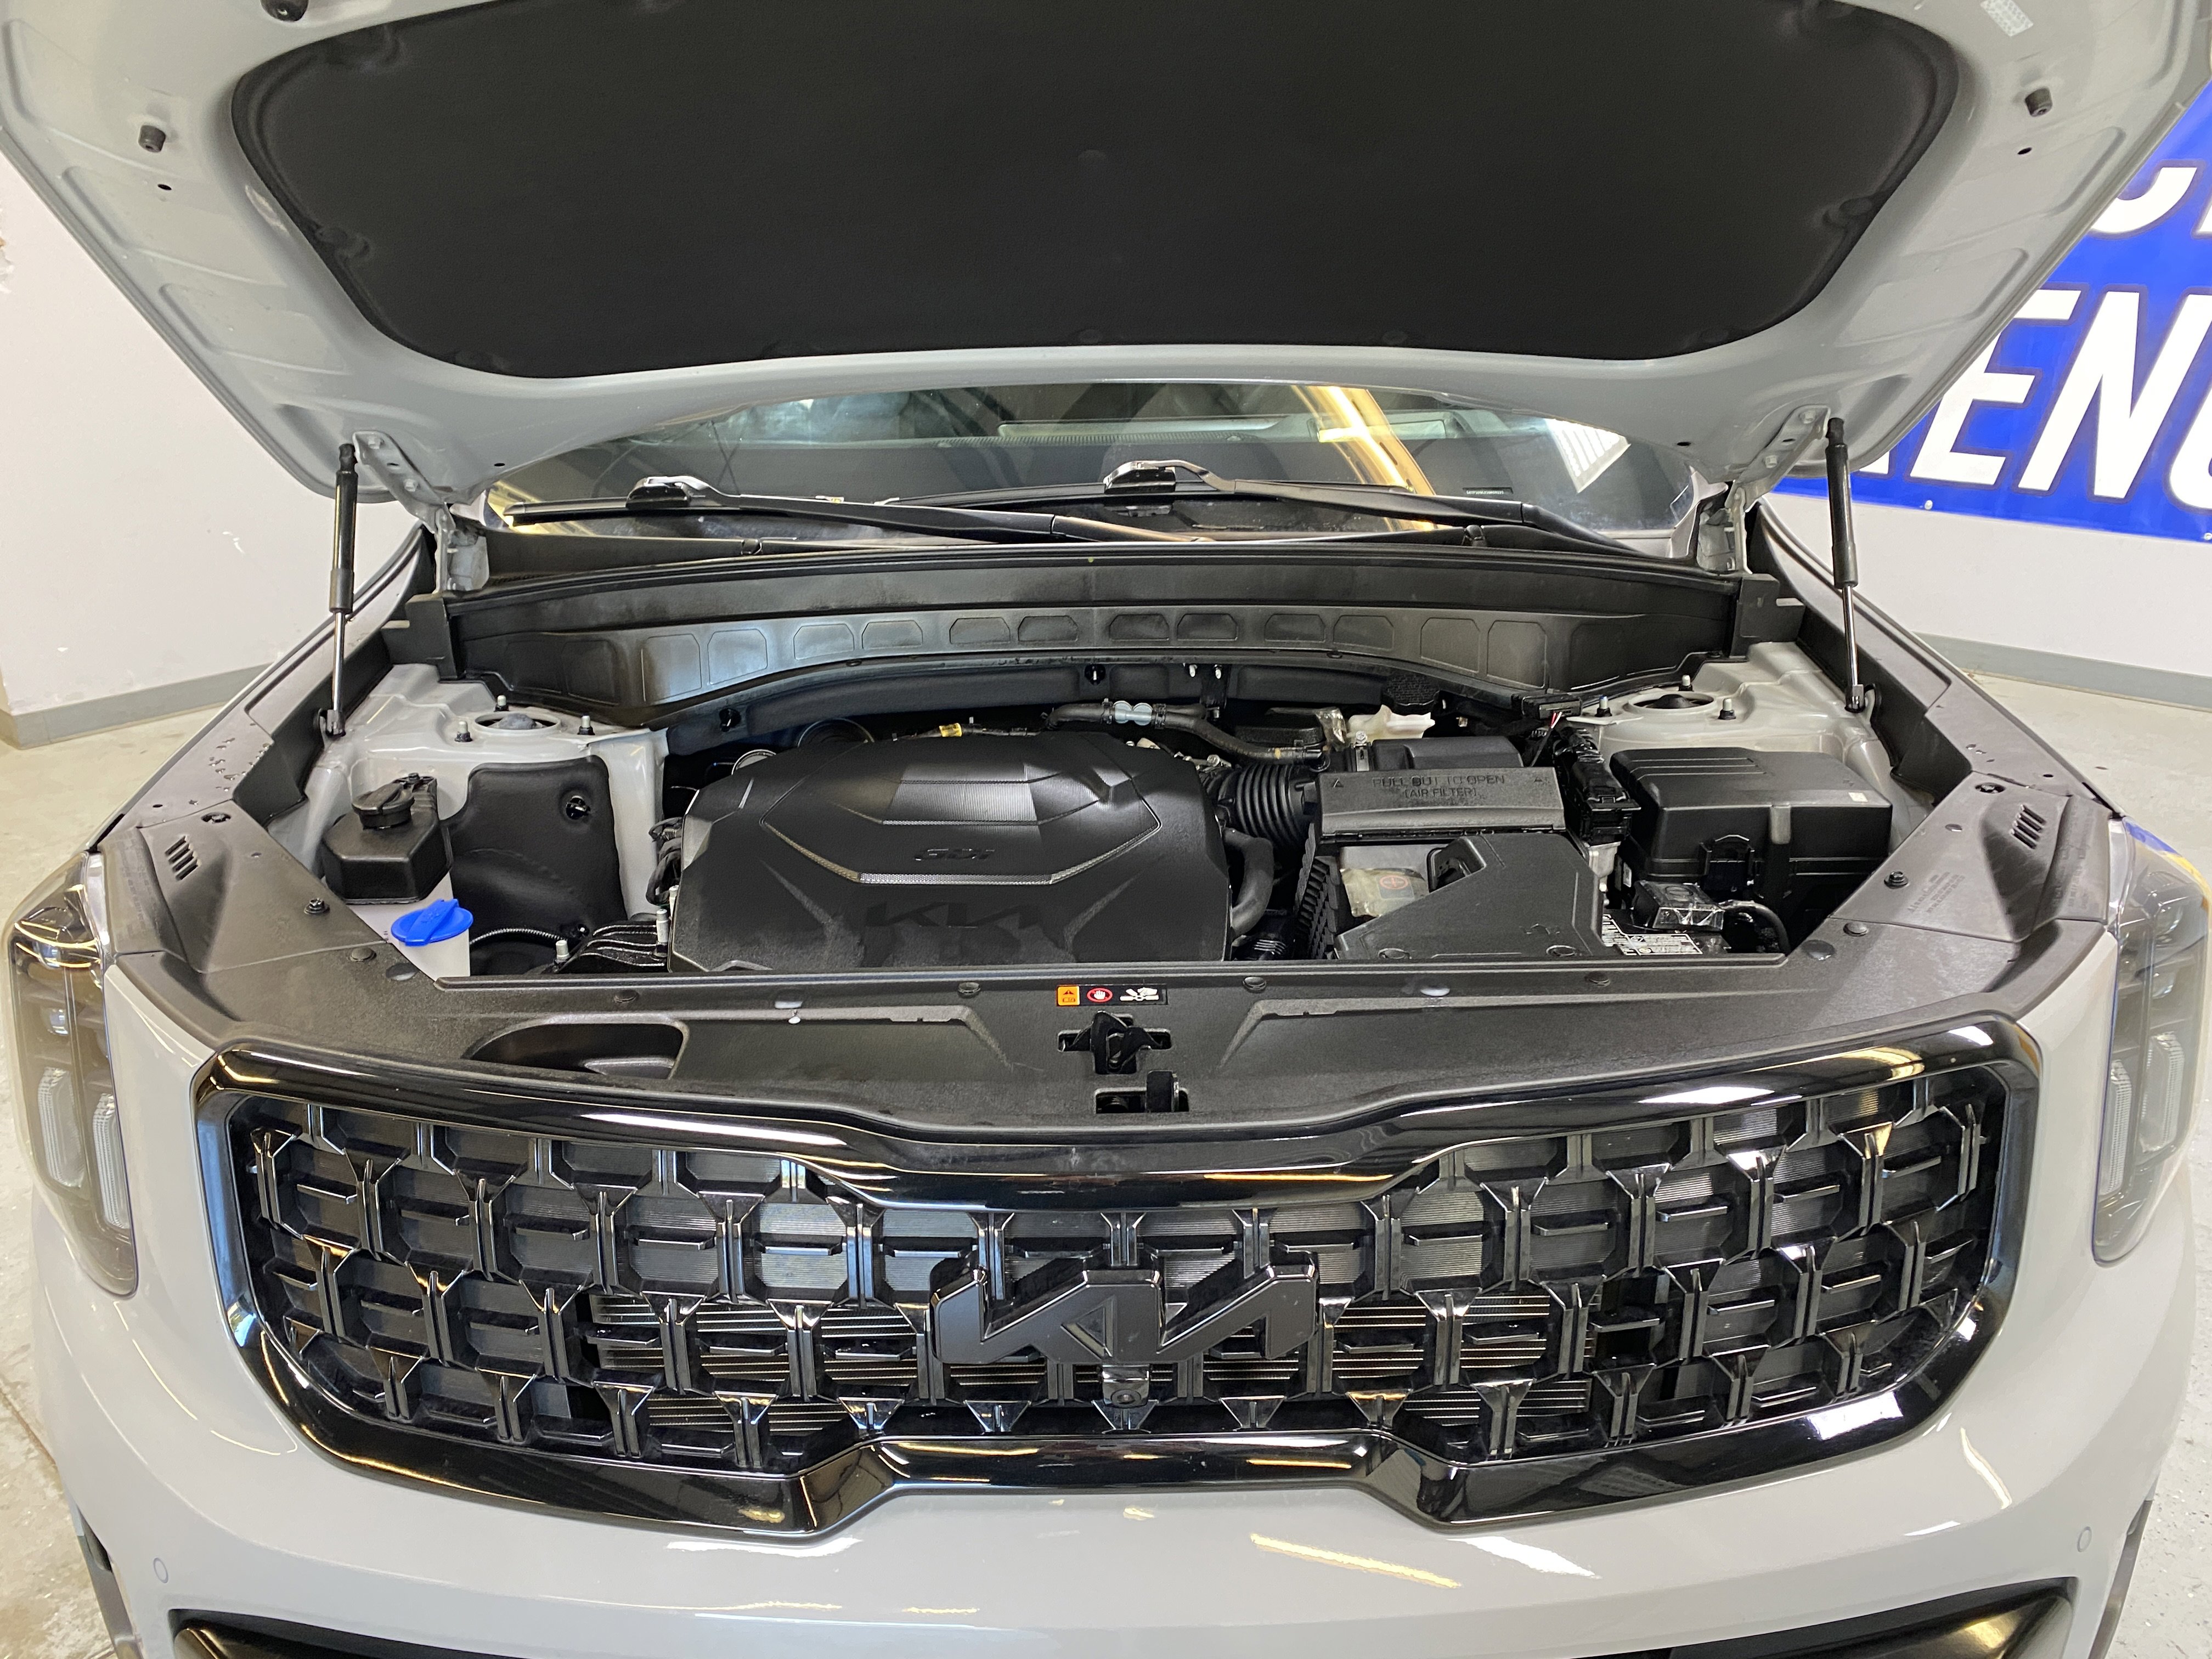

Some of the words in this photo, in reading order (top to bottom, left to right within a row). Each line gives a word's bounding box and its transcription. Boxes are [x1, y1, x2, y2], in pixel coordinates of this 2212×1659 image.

[1859, 290, 2212, 510] EN
[1373, 777, 1406, 787] PULL
[1411, 776, 1438, 786] OUT
[1444, 775, 1464, 785] TO
[1467, 775, 1505, 785] OPEN
[865, 901, 1039, 928] KIA
[931, 1261, 1318, 1364] KIA
